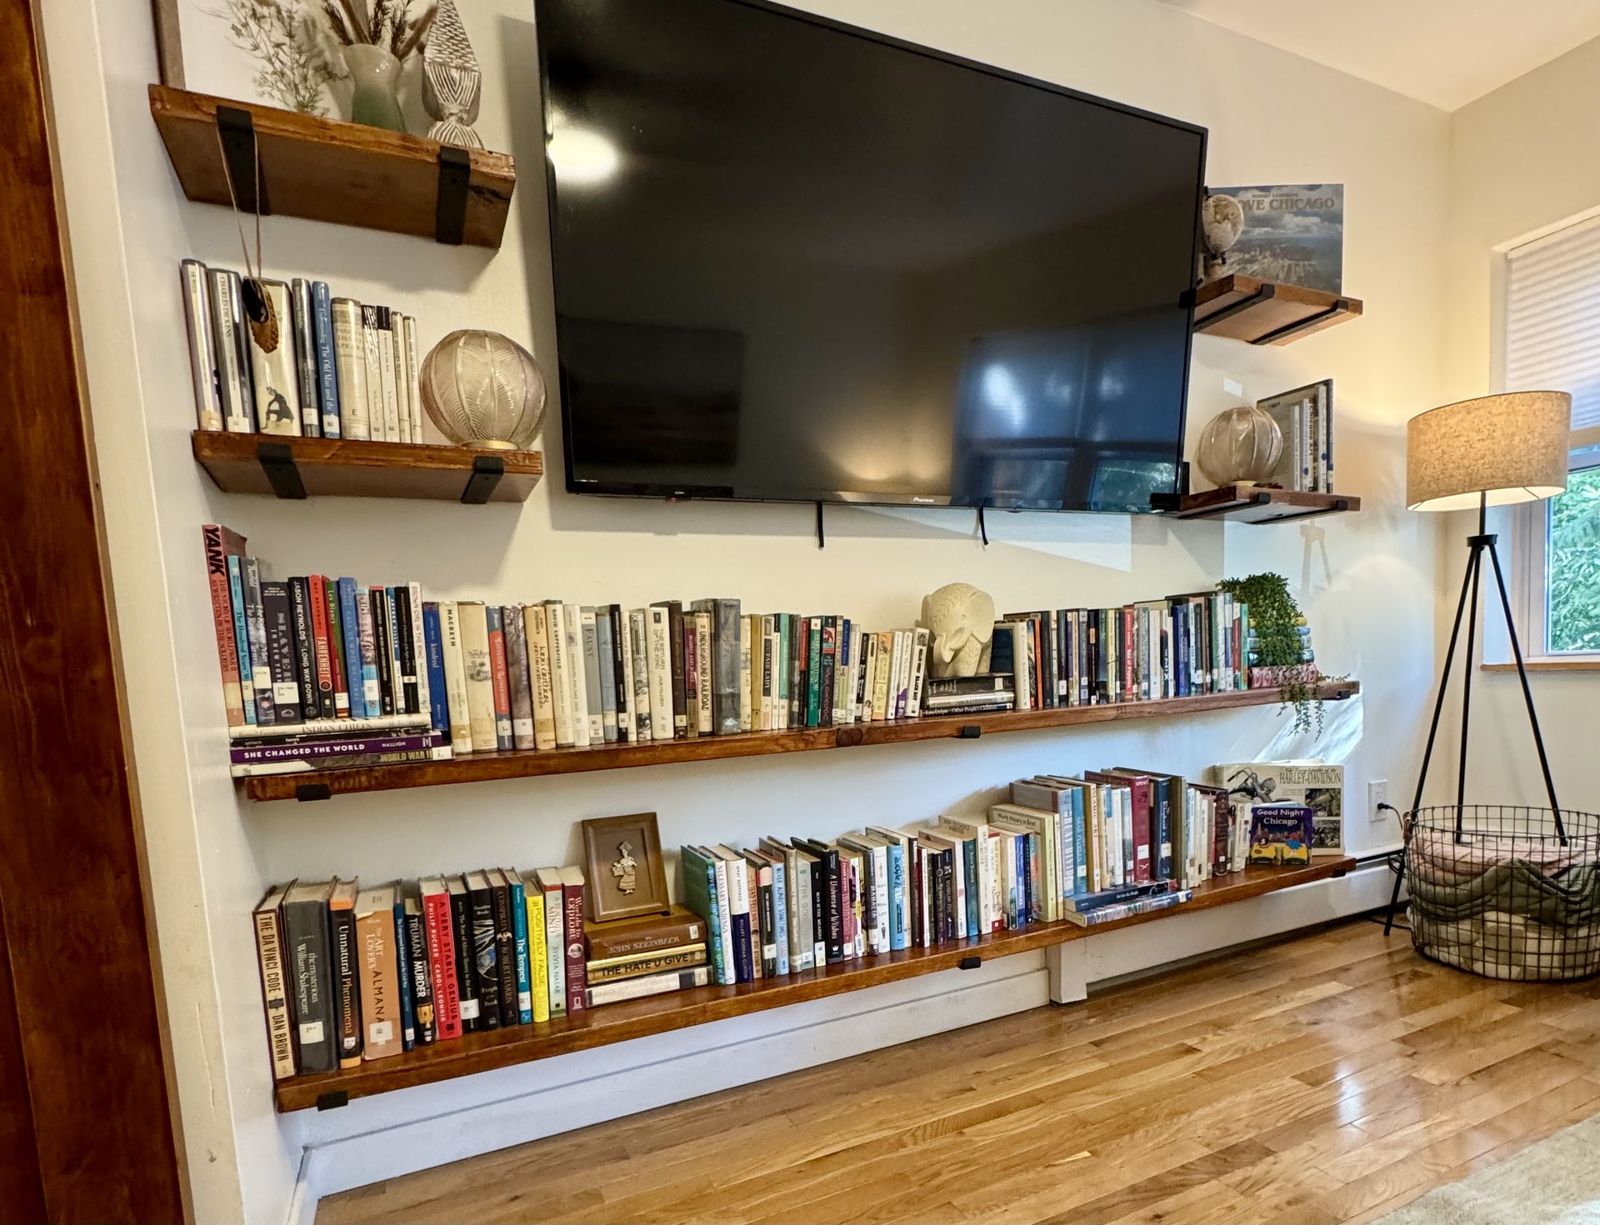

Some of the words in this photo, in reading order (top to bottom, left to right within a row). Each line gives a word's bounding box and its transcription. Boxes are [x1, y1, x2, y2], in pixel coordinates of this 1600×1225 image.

[1269, 197, 1335, 211] CHICAGO
[219, 276, 228, 307] CHARLES
[222, 308, 231, 337] DICKENS
[321, 346, 330, 358] The
[322, 359, 331, 372] Old
[324, 388, 333, 400] and
[205, 526, 224, 577] YANK
[293, 580, 302, 603] JASON
[296, 604, 306, 640] REYNOLDS
[328, 602, 336, 624] Blancs
[237, 625, 246, 652] Hundred
[446, 608, 456, 647] MACBETH
[653, 628, 658, 638] OF
[553, 629, 561, 669] COPPERFIELD
[585, 628, 594, 656] FAUST
[699, 631, 708, 677] UNDERGROUND
[300, 648, 309, 666] LONG
[316, 636, 330, 677] FAHRENHEIT
[303, 668, 311, 684] WAY
[304, 684, 313, 704] DOWN
[700, 678, 709, 711] RAILROAD
[265, 748, 310, 757] CHANGED
[333, 744, 365, 752] WORLD
[408, 751, 424, 760] WAR
[1280, 772, 1340, 785] HARLEY-DAVIDSON
[1263, 818, 1298, 826] Chicago
[1280, 809, 1304, 817] Night
[707, 865, 715, 887] ABOVE
[716, 865, 726, 903] NECESSARY
[829, 880, 838, 908] Universe
[869, 885, 877, 918] MAHALIA
[258, 916, 273, 932] THE
[427, 902, 435, 926] PHILIP
[440, 912, 449, 937] VERY
[497, 891, 507, 932] CONSPIRATA
[547, 906, 555, 934] MIND
[719, 904, 728, 933] ENDINGS
[777, 909, 785, 937] SOMETIMES
[261, 933, 275, 945] DA
[408, 917, 421, 957] TRUMAN
[534, 907, 543, 955] POSITIVELY
[575, 928, 581, 937] to
[830, 916, 839, 939] Wishes
[338, 925, 351, 975] Unnatural
[366, 933, 376, 968] LOVER'S
[374, 937, 384, 956] ART
[430, 929, 438, 957] RUCKER
[516, 938, 525, 952] The
[633, 936, 680, 950] STEINBECK
[262, 946, 278, 970] VINCI
[296, 943, 308, 971] William
[308, 952, 317, 964] the
[443, 942, 454, 979] STABLE
[501, 947, 510, 974] ROBERT
[517, 952, 527, 983] Tempest
[551, 946, 559, 969] SYLVIA
[602, 965, 621, 976] THE
[624, 960, 652, 972] HATE
[654, 959, 660, 967] U
[664, 954, 689, 964] GIVE
[266, 971, 281, 993] CODE
[307, 964, 320, 1003] mysterious
[412, 960, 426, 998] MURDER
[434, 964, 442, 988] CAROL
[537, 958, 545, 986] FALSE
[552, 971, 560, 994] NASAR
[297, 971, 311, 1015] Shakespeare
[371, 969, 386, 1023] ALMANA
[447, 983, 458, 1020] GENIUS
[503, 976, 512, 1004] HARRIS
[342, 977, 354, 1034] Phenomena
[436, 990, 445, 1022] LEONNIG
[271, 1013, 286, 1030] DAN
[274, 1032, 290, 1062] BROWN
